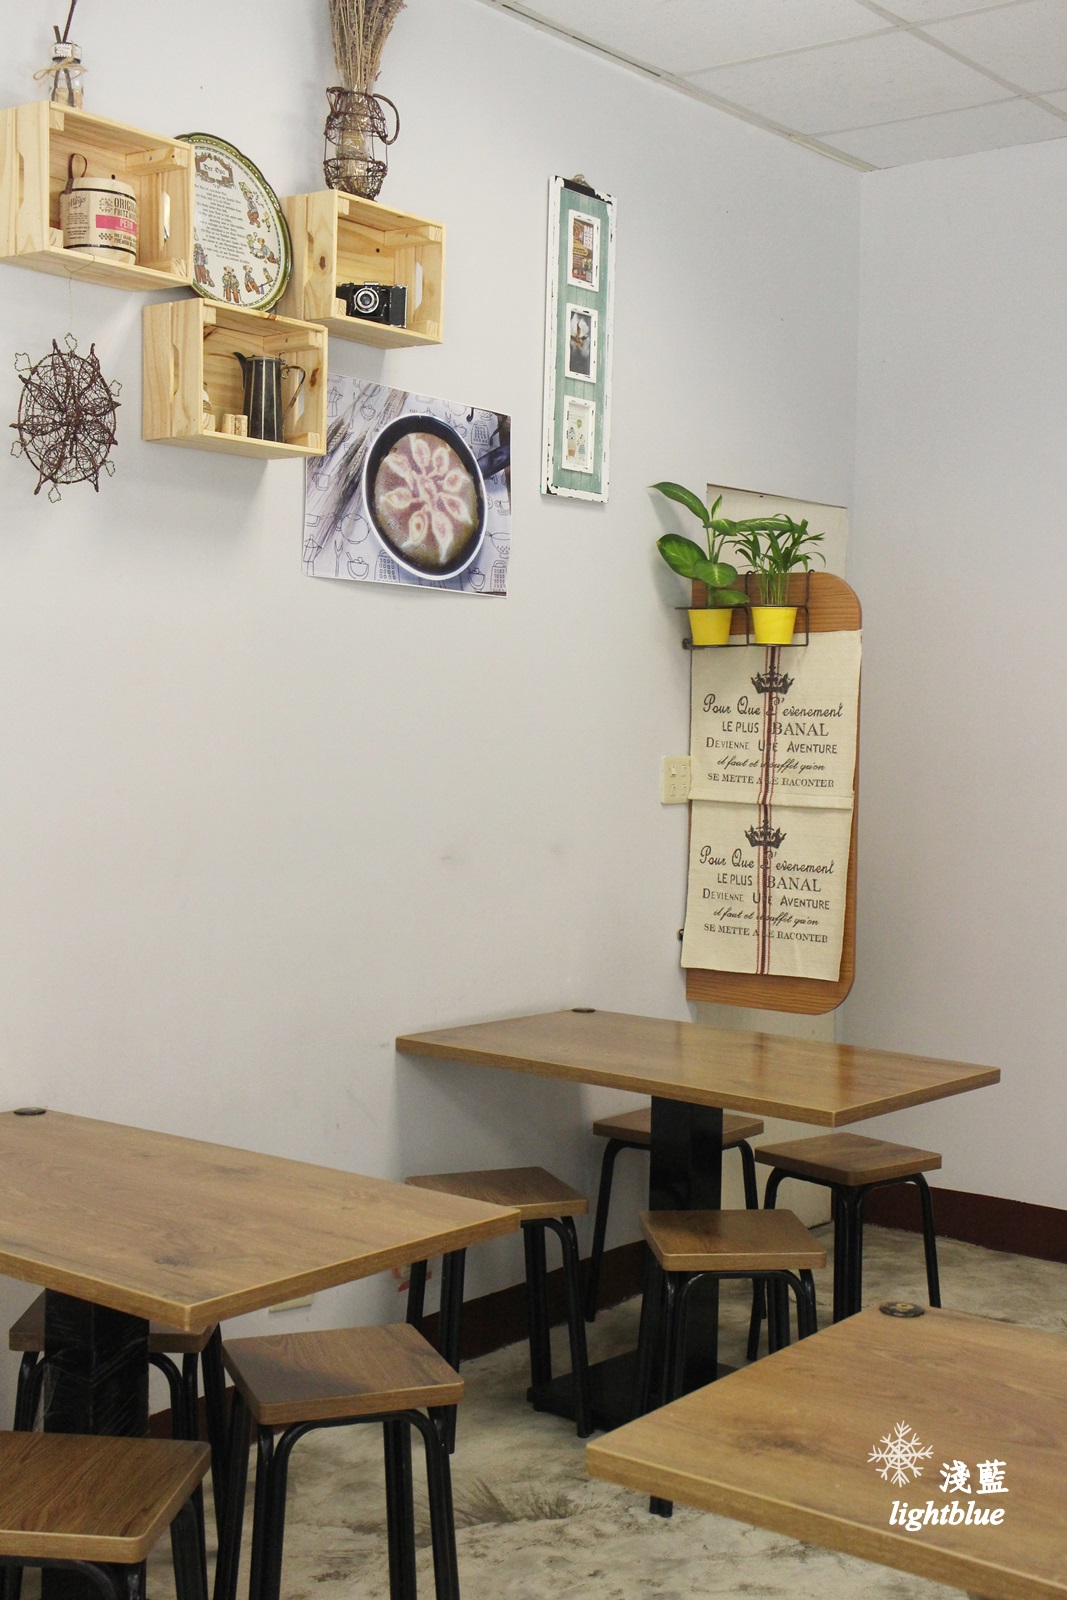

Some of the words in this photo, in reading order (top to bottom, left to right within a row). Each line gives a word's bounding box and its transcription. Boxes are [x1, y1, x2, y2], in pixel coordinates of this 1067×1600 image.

[703, 693, 731, 714] Pour
[737, 696, 760, 716] Que
[722, 721, 733, 732] LE
[736, 722, 760, 734] PLUS
[771, 722, 829, 736] BANAL
[706, 737, 750, 750] DEVIENNE
[758, 739, 778, 752] UE
[787, 740, 838, 754] AVENTURE
[724, 756, 749, 770] faut
[708, 773, 719, 781] SE
[722, 774, 754, 784] METTE
[781, 778, 834, 788] RACONTER
[700, 846, 726, 865] Pour
[732, 848, 755, 869] Que
[717, 873, 728, 884] LE
[730, 873, 753, 886] PLUS
[767, 875, 822, 892] BANAL
[702, 888, 744, 902] DEVIENNE
[752, 892, 772, 905] UE
[780, 895, 830, 910] AVENTURE
[720, 908, 742, 920] faut
[744, 911, 754, 920] et
[717, 925, 750, 936] METTE
[776, 931, 828, 943] RACONTER
